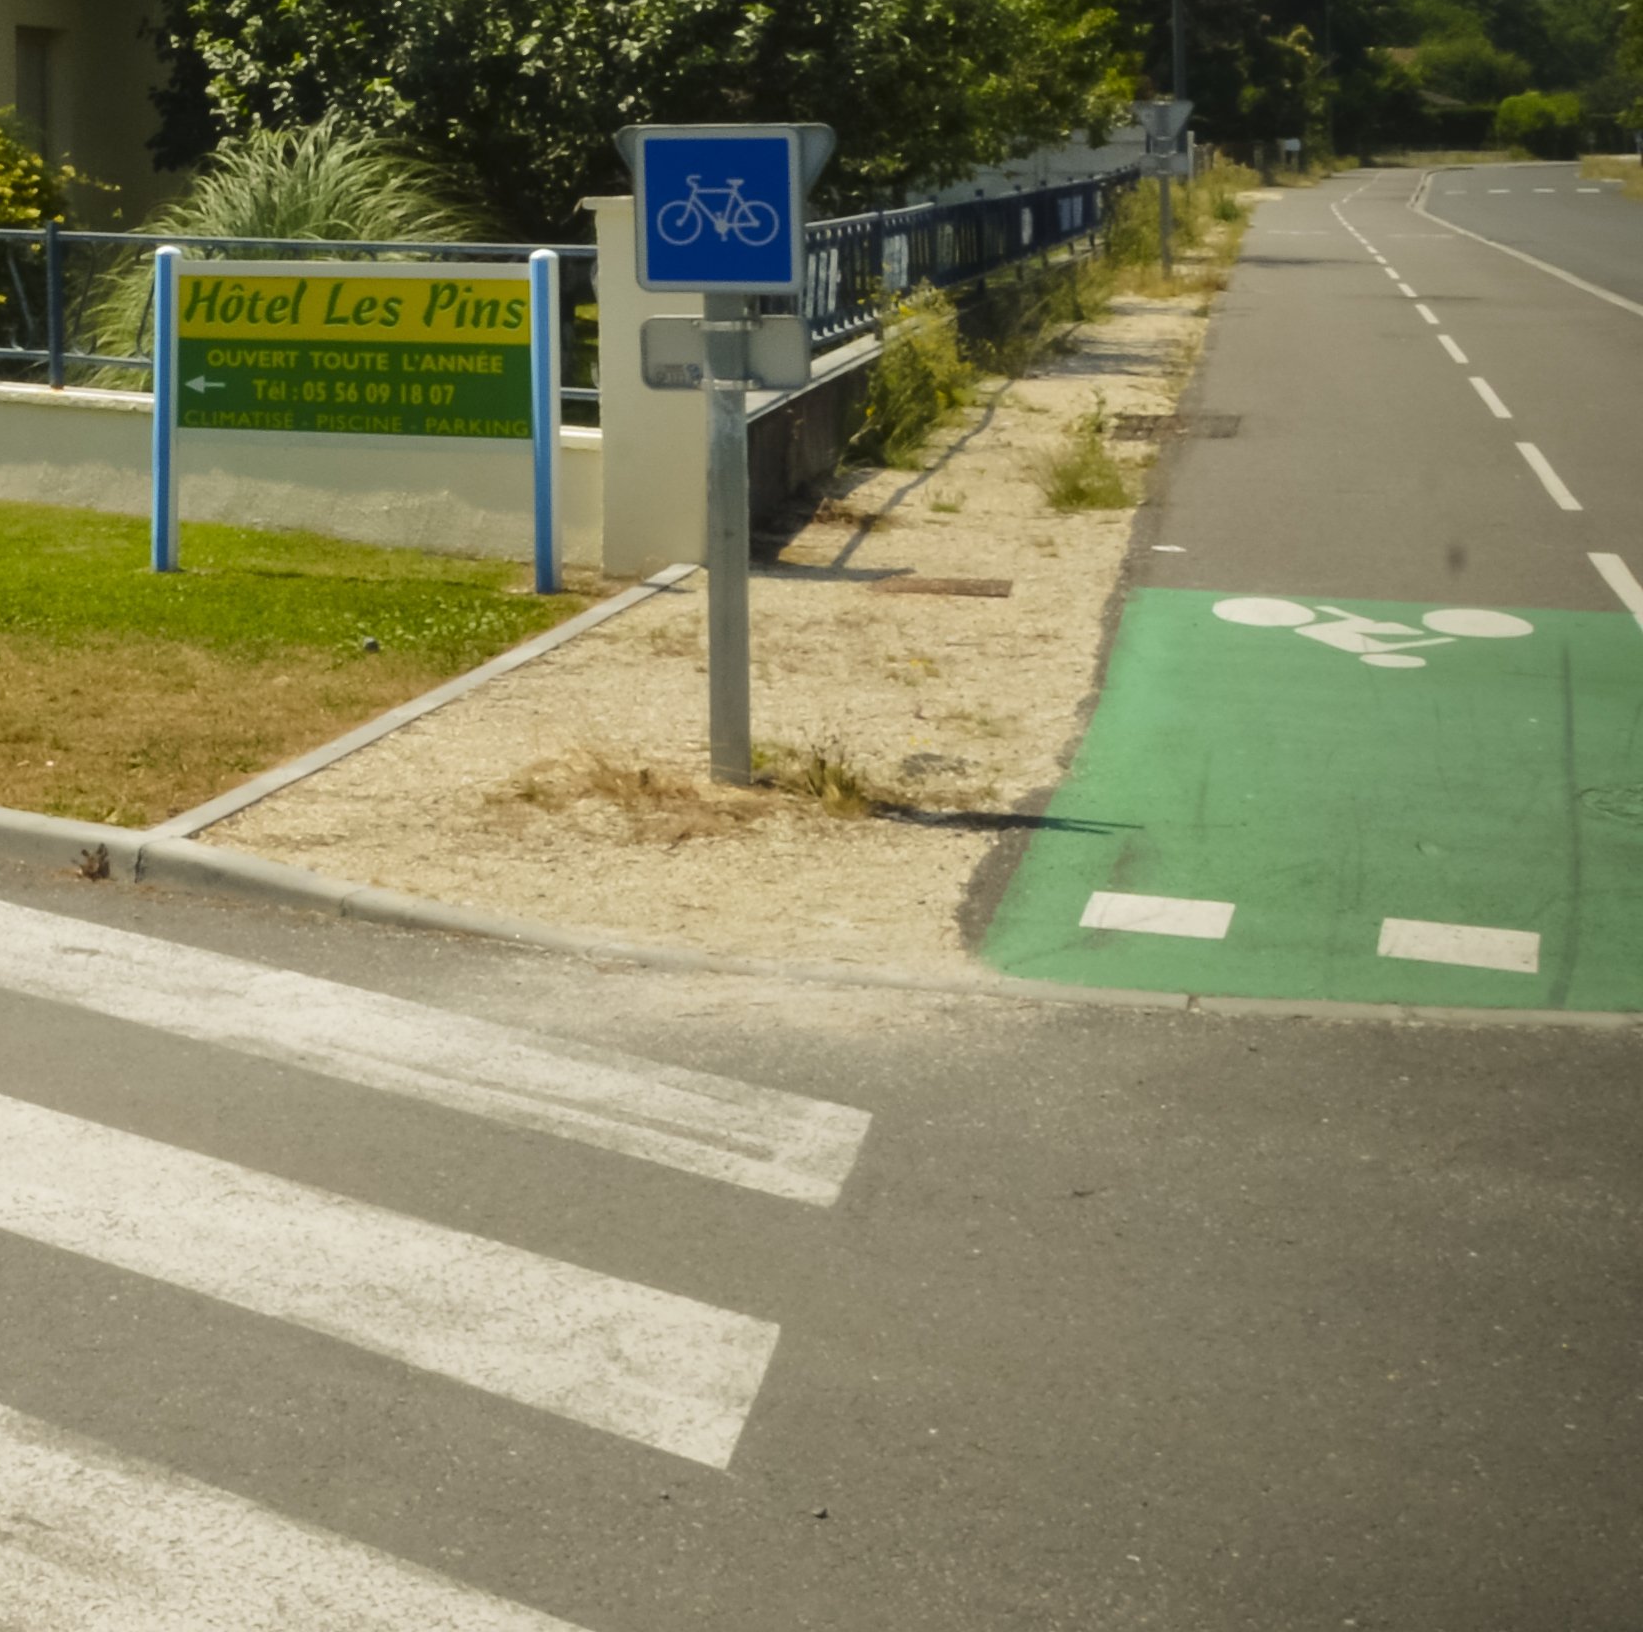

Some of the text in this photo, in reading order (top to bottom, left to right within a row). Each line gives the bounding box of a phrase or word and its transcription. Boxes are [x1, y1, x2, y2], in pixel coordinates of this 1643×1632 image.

[184, 279, 527, 329] Hôtel Les Pins
[207, 349, 504, 374] OUVERT TOUTE L'ANNÉE
[302, 381, 326, 401] 05
[335, 382, 358, 402] 56
[366, 383, 391, 403] 09
[400, 383, 422, 404] 18
[429, 385, 455, 405] 07
[317, 414, 403, 433] PISCINE
[425, 418, 528, 437] PARKING
